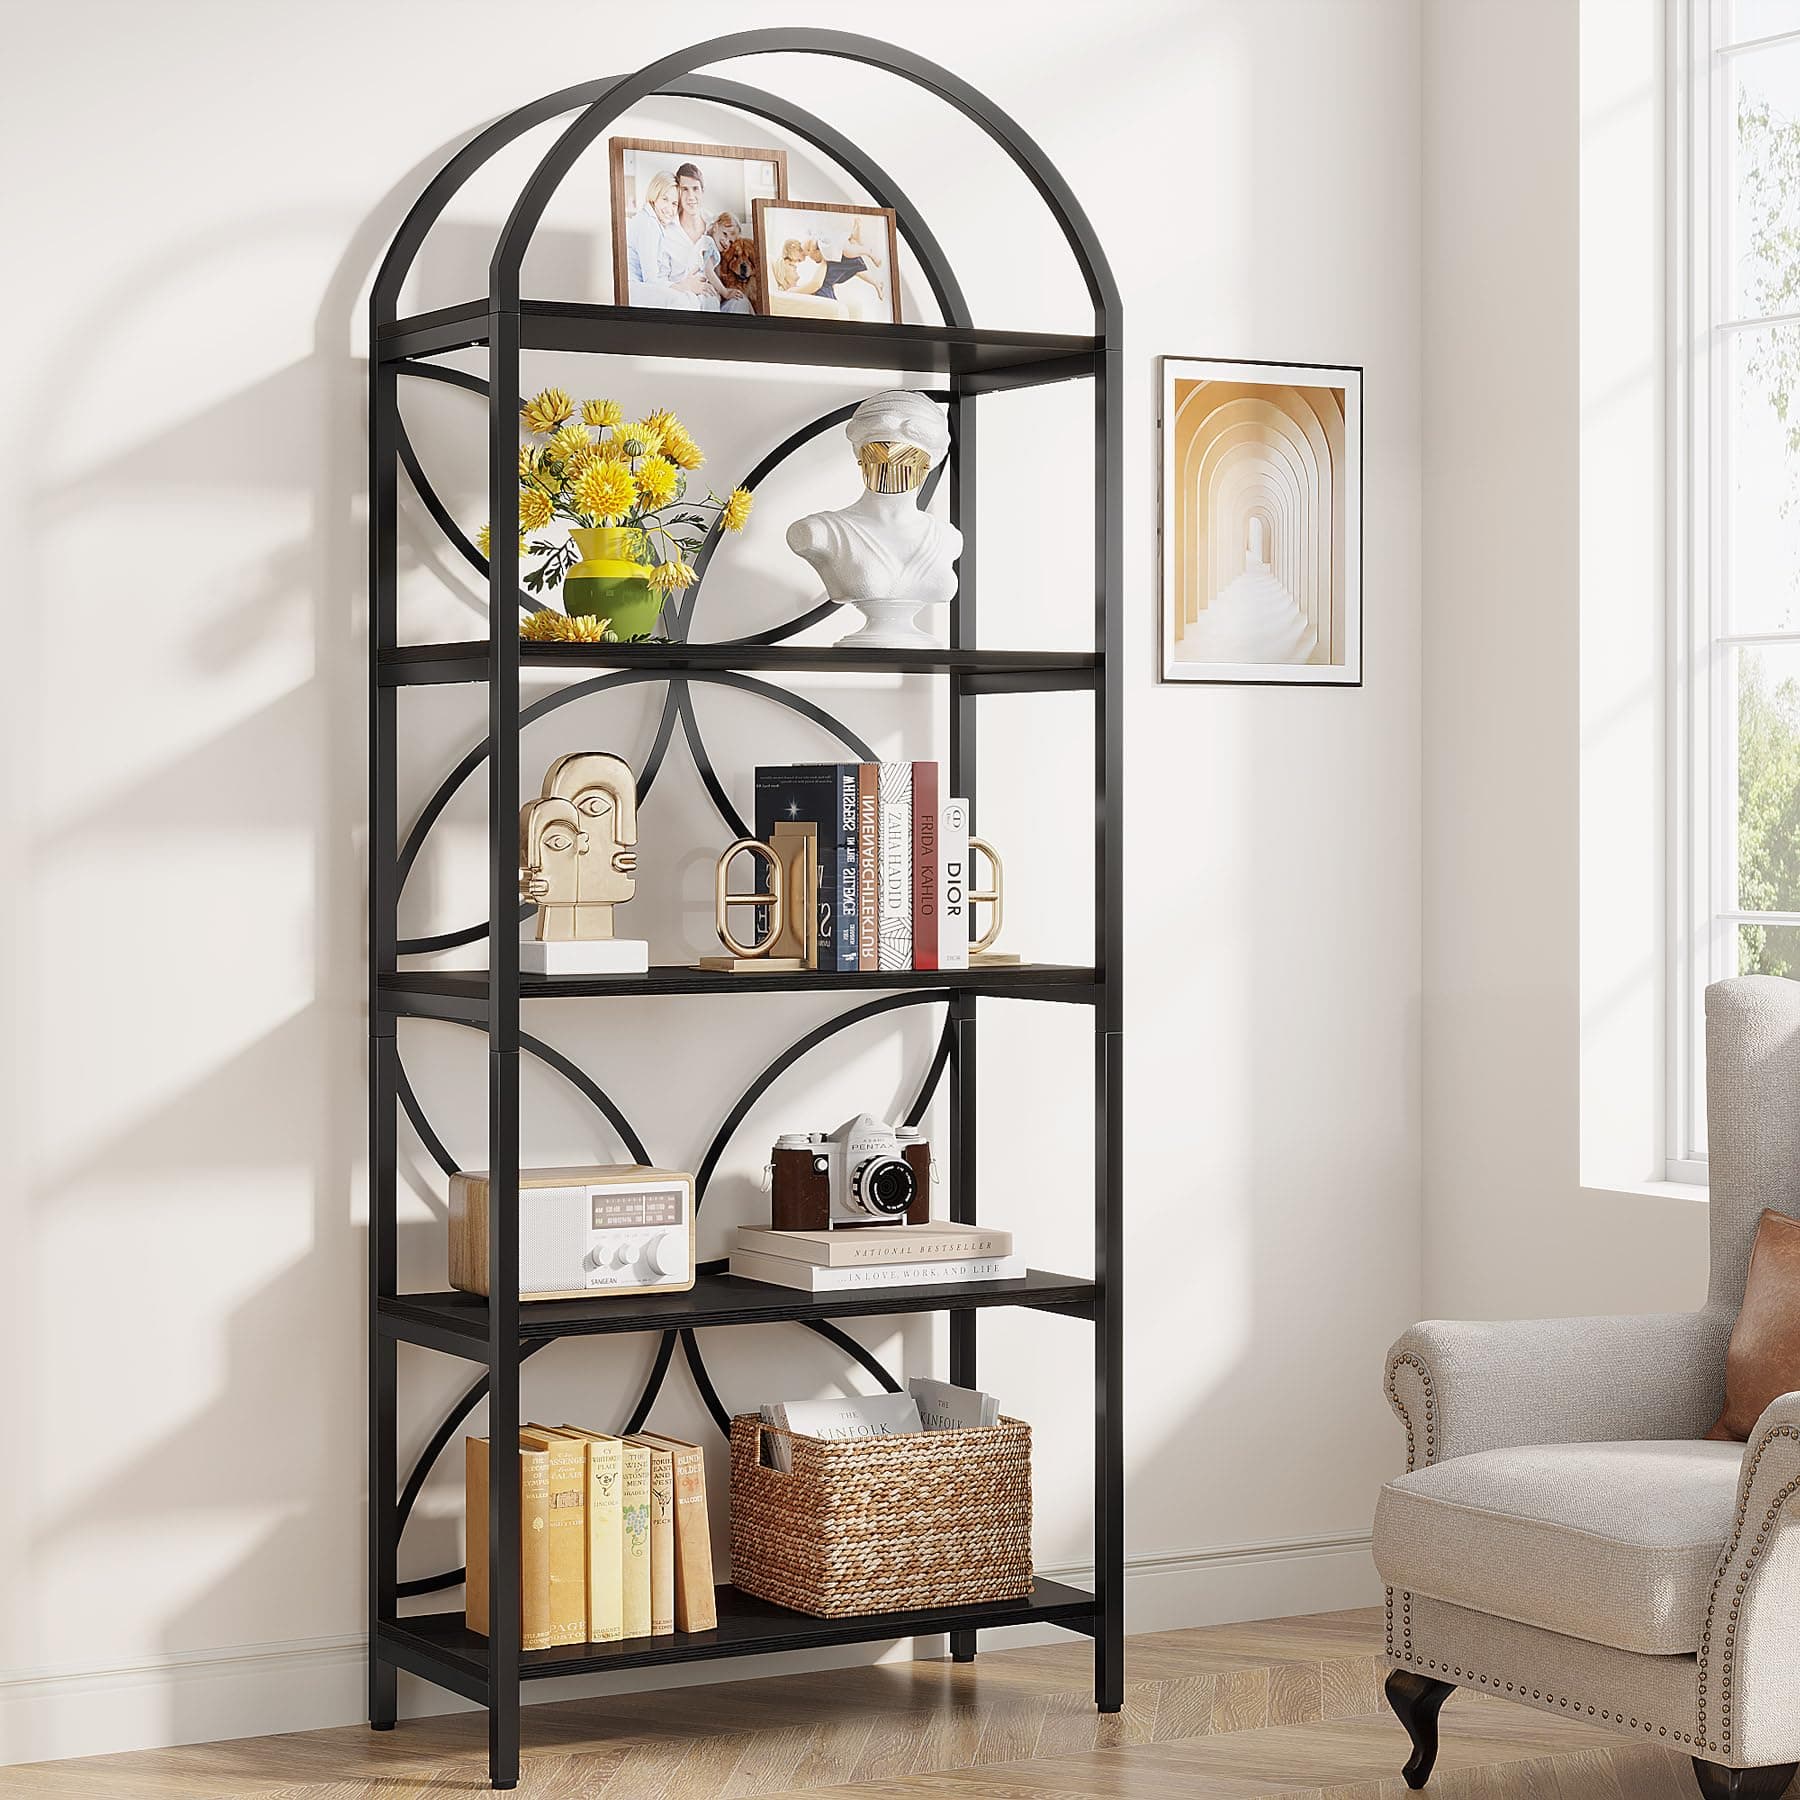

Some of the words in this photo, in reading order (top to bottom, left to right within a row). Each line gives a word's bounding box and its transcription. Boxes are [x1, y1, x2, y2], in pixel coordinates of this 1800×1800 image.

[888, 812, 902, 850] ZAHA
[920, 815, 934, 856] FRIDA
[888, 854, 902, 909] HADID
[920, 865, 934, 916] KAHLO
[946, 862, 962, 917] DIOR
[851, 1143, 896, 1151] PENTAX
[854, 1246, 913, 1257] NATIONAL
[919, 1241, 993, 1253] BESTSELLER
[943, 1266, 967, 1276] AND
[972, 1263, 1000, 1275] LIFE
[840, 1411, 858, 1420] THE
[815, 1422, 892, 1440] KINFOLK
[549, 1620, 587, 1633] PAGE
